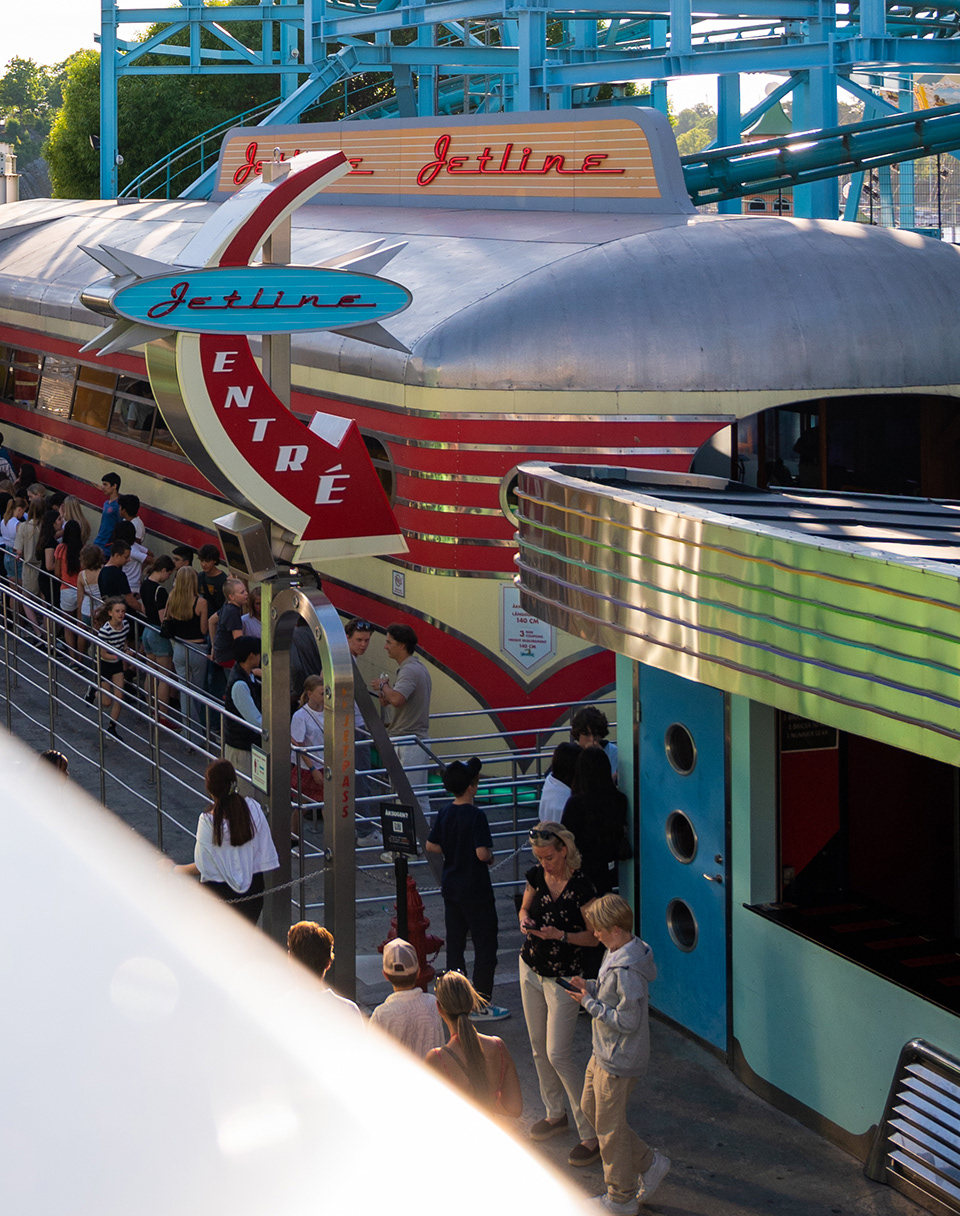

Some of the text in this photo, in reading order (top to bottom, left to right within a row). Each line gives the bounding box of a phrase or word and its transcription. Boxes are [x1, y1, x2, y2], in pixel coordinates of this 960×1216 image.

[417, 133, 626, 186] Jetline
[147, 281, 377, 318] Jetline
[212, 351, 350, 505] ENTRÉ
[341, 714, 351, 818] JETPASS
